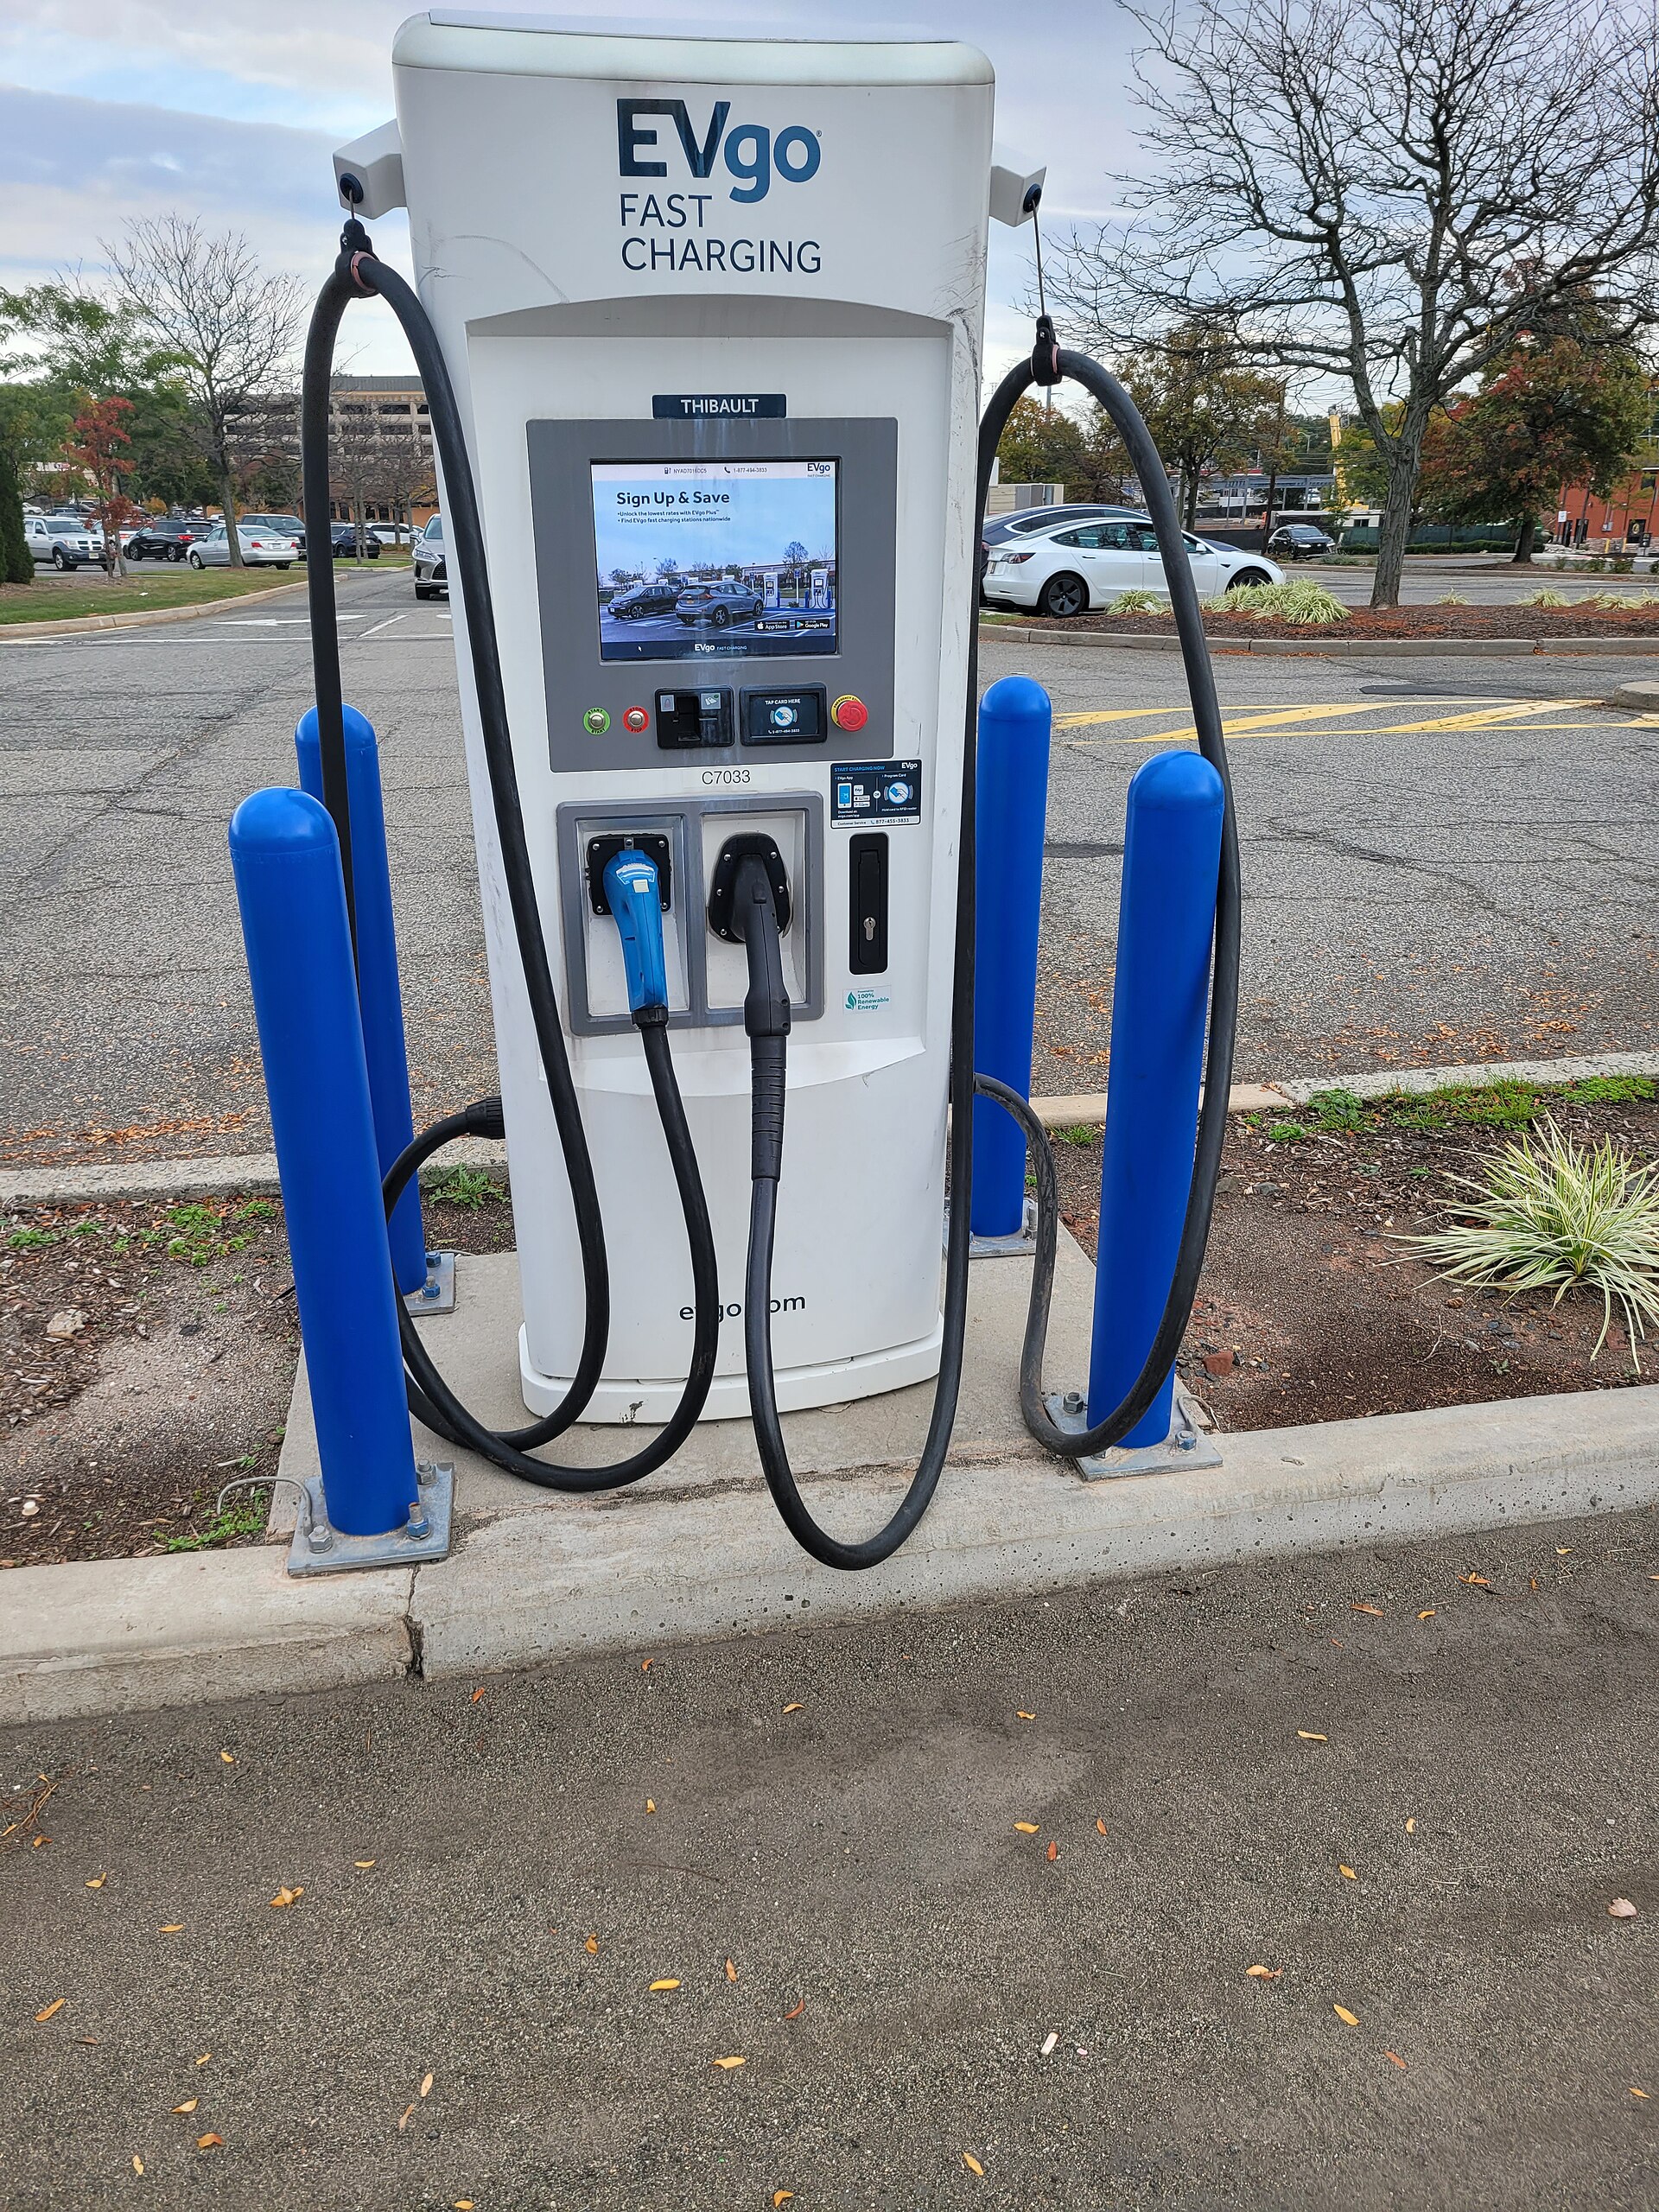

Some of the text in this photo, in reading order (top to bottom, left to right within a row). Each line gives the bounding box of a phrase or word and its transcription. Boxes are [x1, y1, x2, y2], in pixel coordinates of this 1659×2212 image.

[620, 194, 712, 227] FAST
[621, 238, 821, 274] CHARGING
[680, 399, 759, 413] THIBAULT
[807, 463, 830, 474] EVgo
[617, 491, 729, 508] Sign Up & Save
[695, 644, 715, 652] EVgo
[702, 770, 751, 785] C7033
